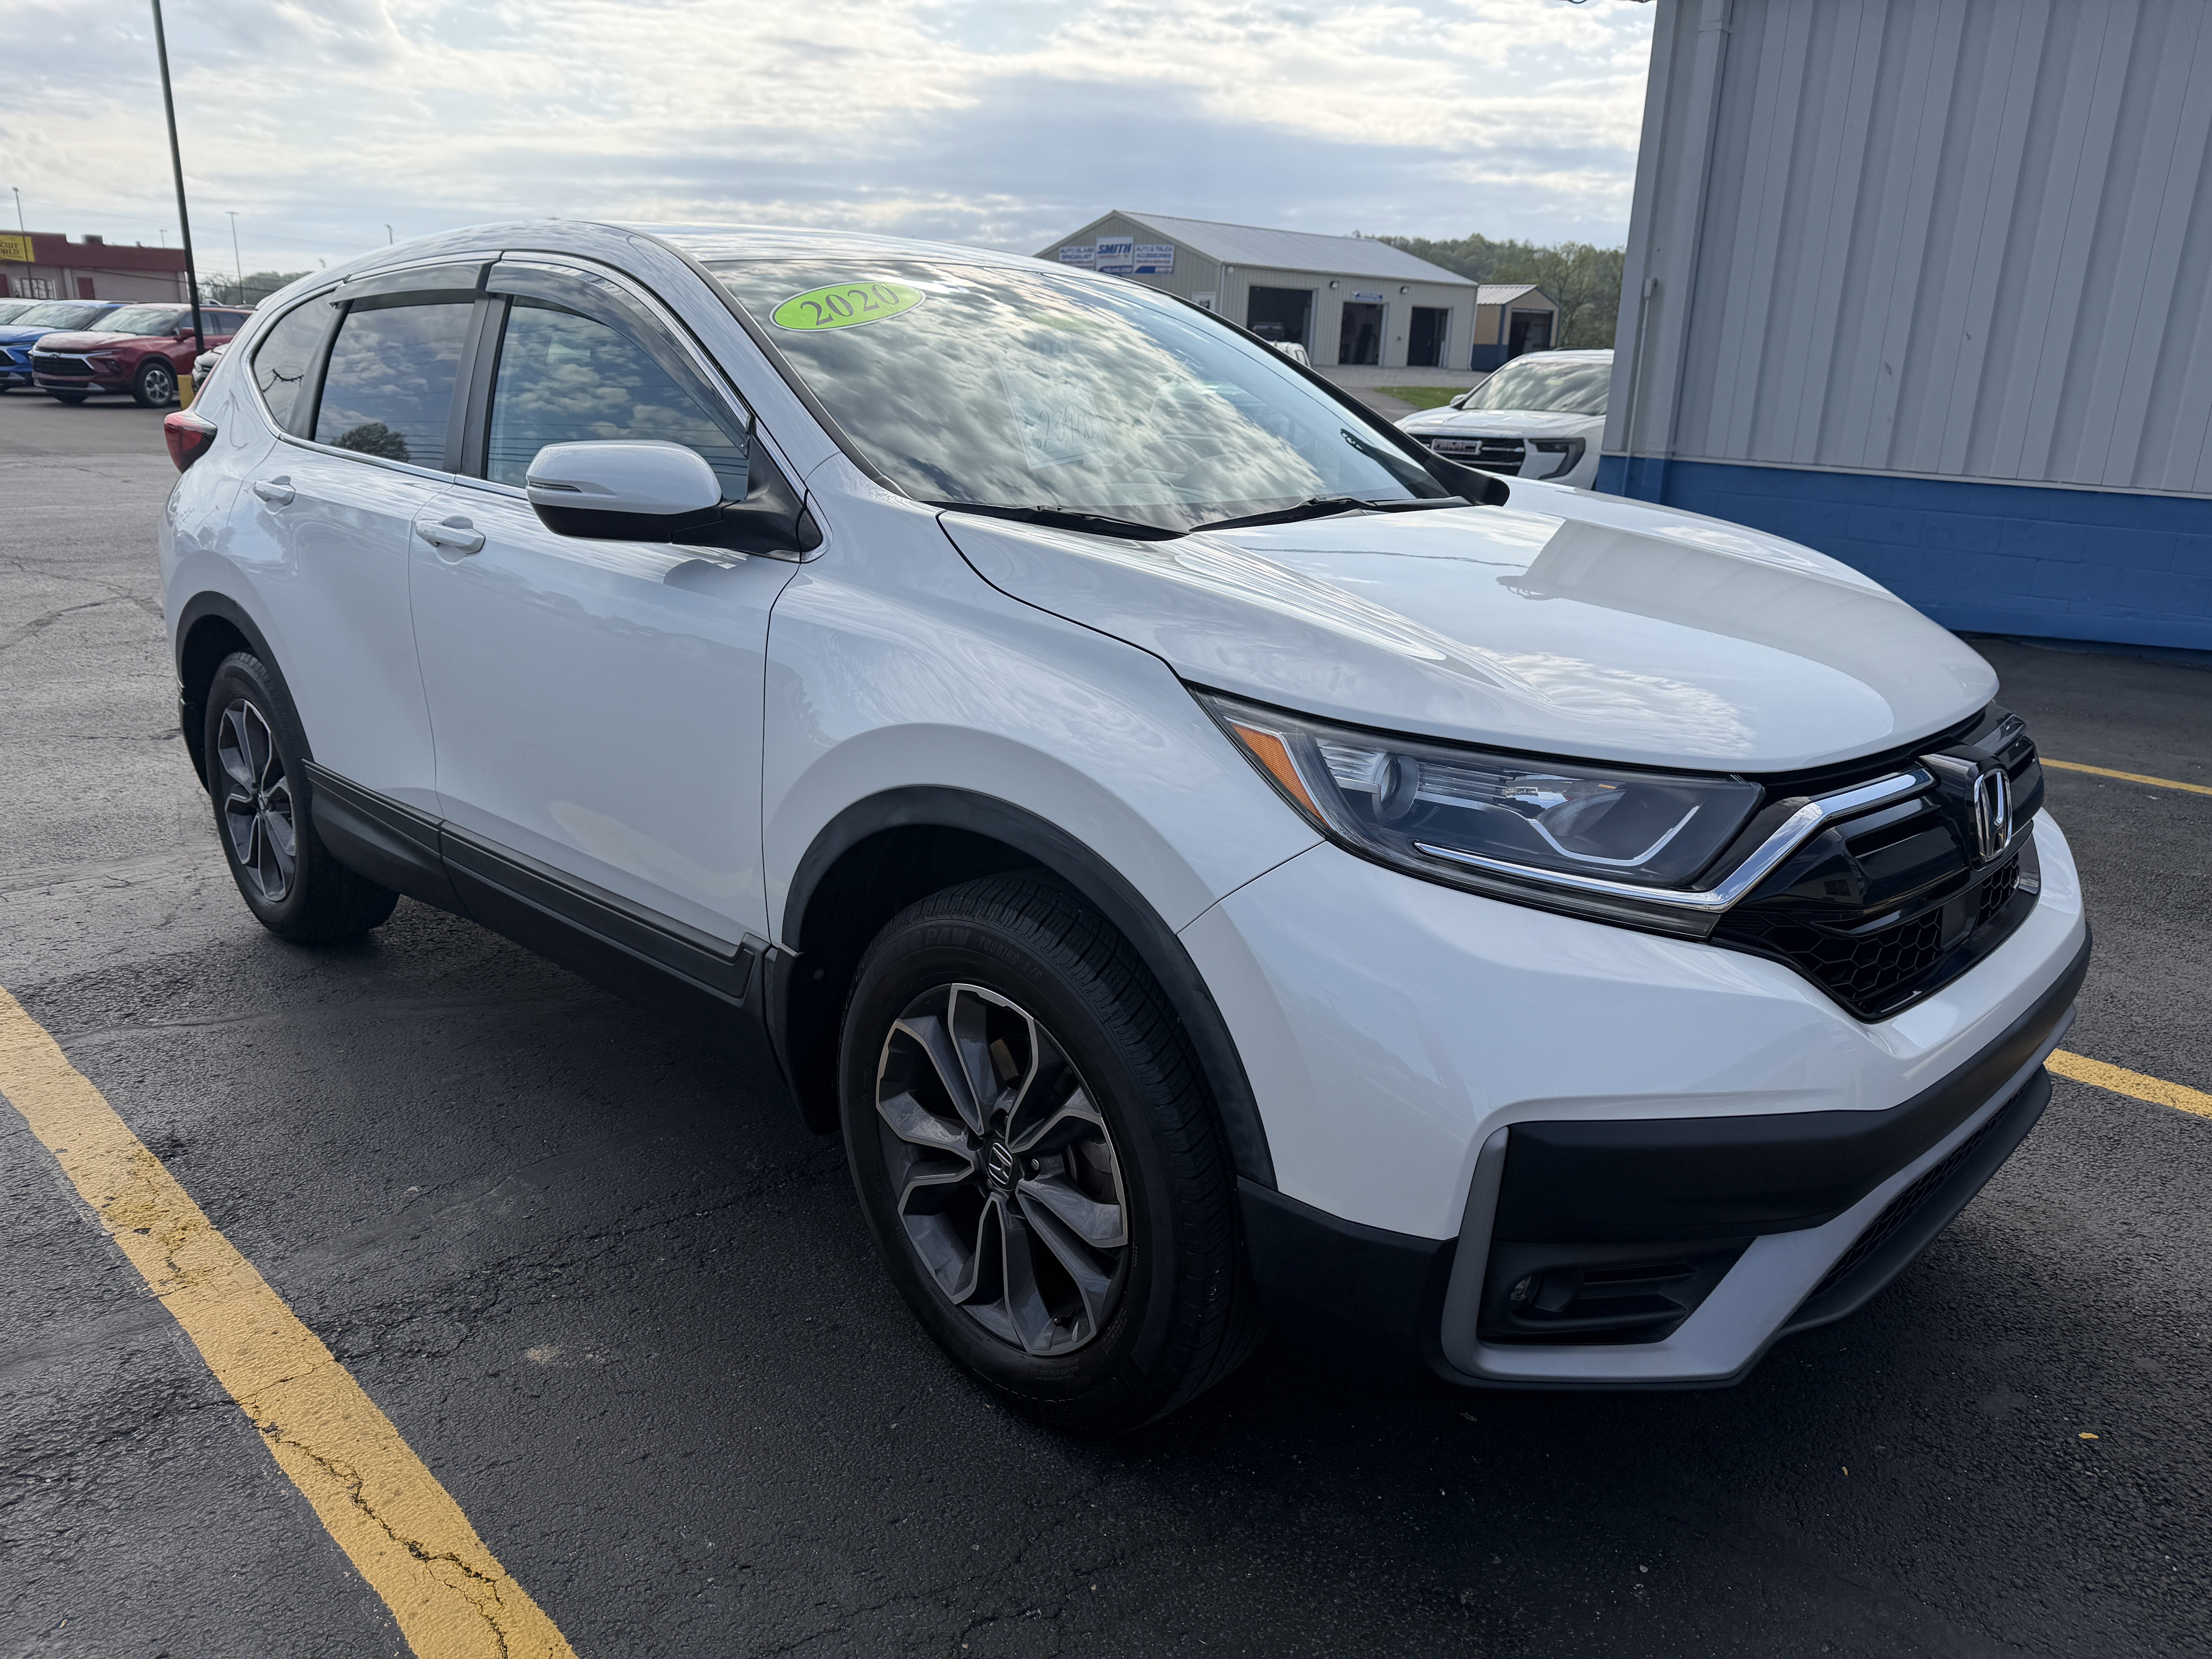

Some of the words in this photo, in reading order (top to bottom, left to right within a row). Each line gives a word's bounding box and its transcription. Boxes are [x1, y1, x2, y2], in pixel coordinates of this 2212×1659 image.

[1098, 243, 1132, 254] SMITH
[800, 284, 899, 326] 2020
[1434, 441, 1476, 452] GMC
[980, 936, 1020, 965] TOURING
